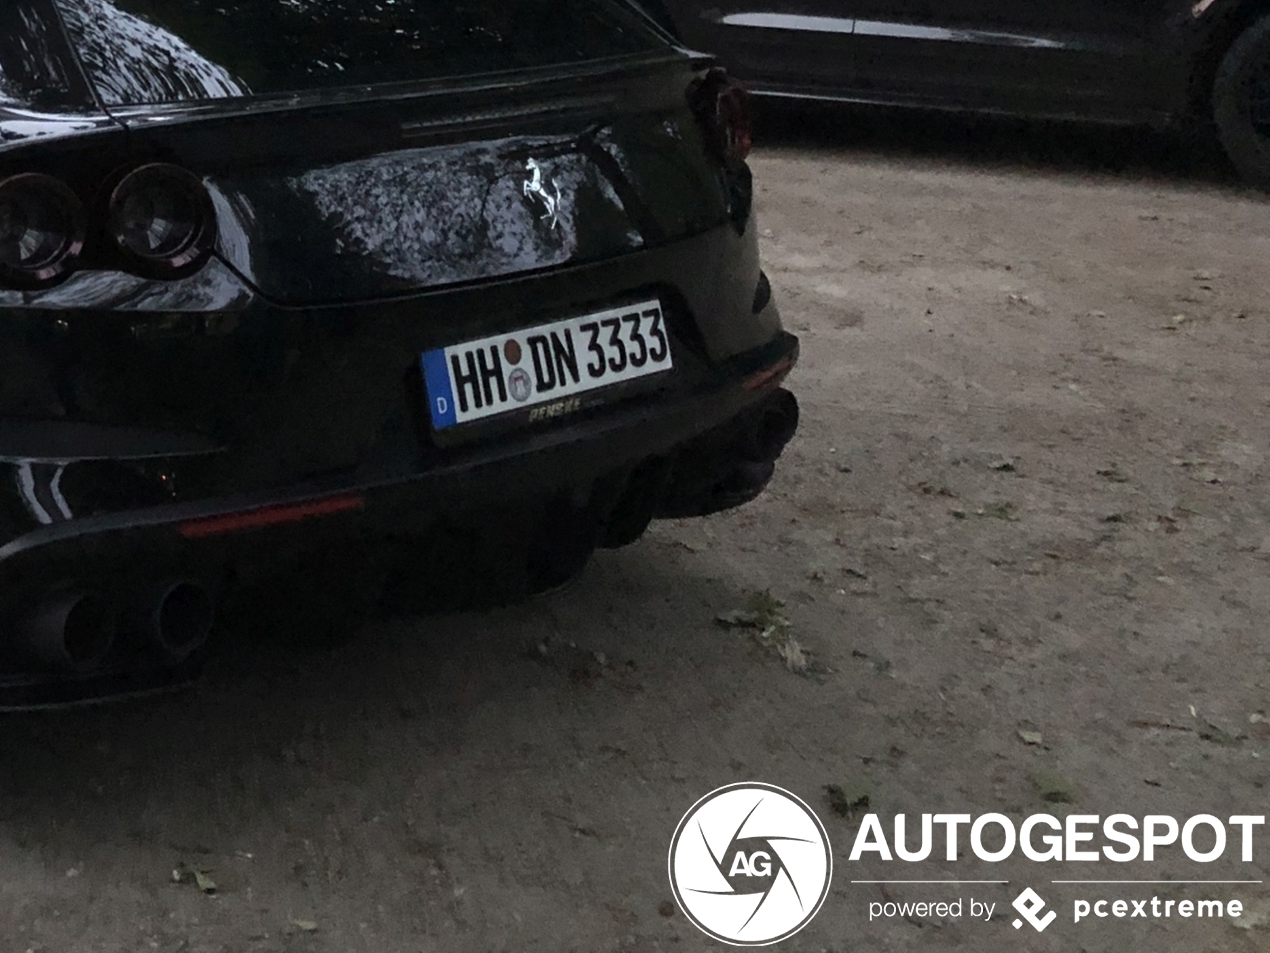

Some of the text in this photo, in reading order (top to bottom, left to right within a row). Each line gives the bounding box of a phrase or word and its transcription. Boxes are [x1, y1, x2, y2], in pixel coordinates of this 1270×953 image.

[451, 308, 668, 412] HH DN 3333
[436, 397, 448, 414] D
